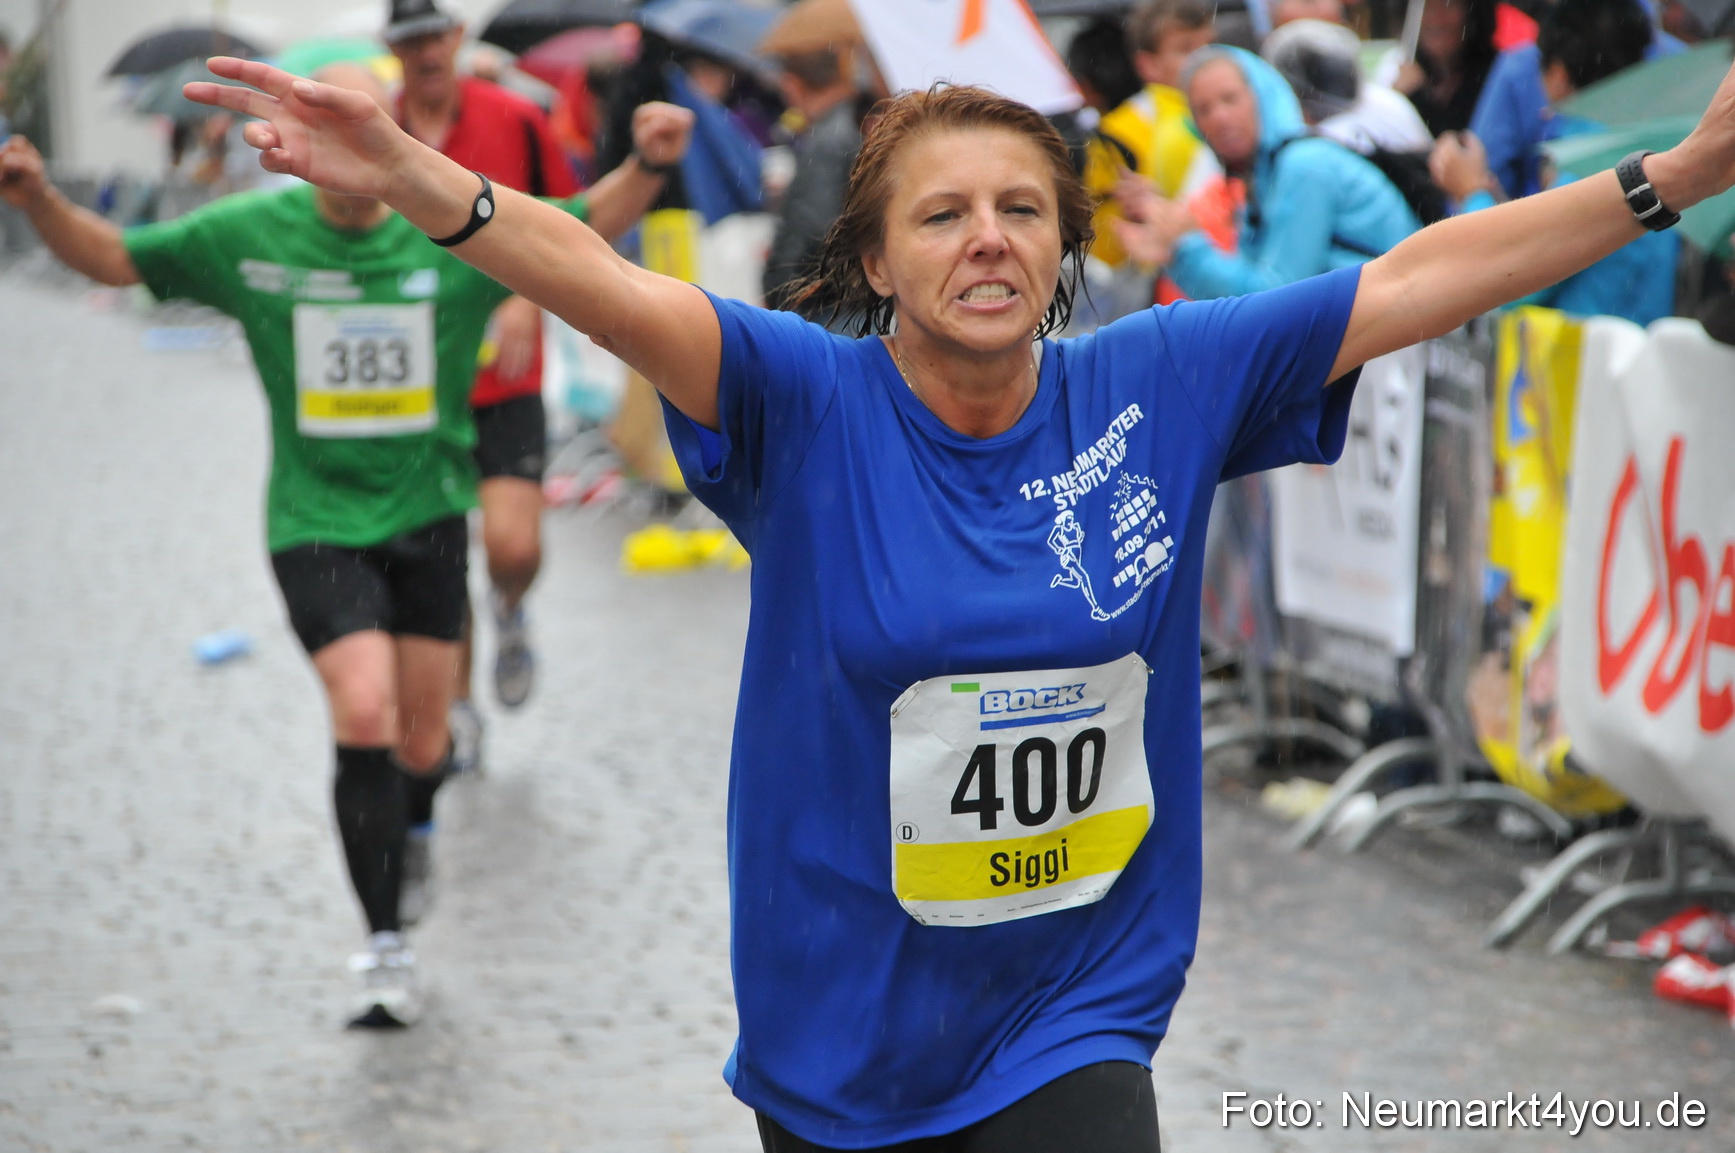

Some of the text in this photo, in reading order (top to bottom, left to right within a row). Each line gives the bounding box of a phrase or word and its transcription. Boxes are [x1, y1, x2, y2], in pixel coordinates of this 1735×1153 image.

[325, 339, 411, 386] 383
[1019, 479, 1052, 501] 12.
[1053, 437, 1127, 511] STADTLAUF
[980, 683, 1086, 715] BOCK
[951, 727, 1106, 831] 400
[902, 825, 913, 841] D
[990, 838, 1069, 888] Siggi
